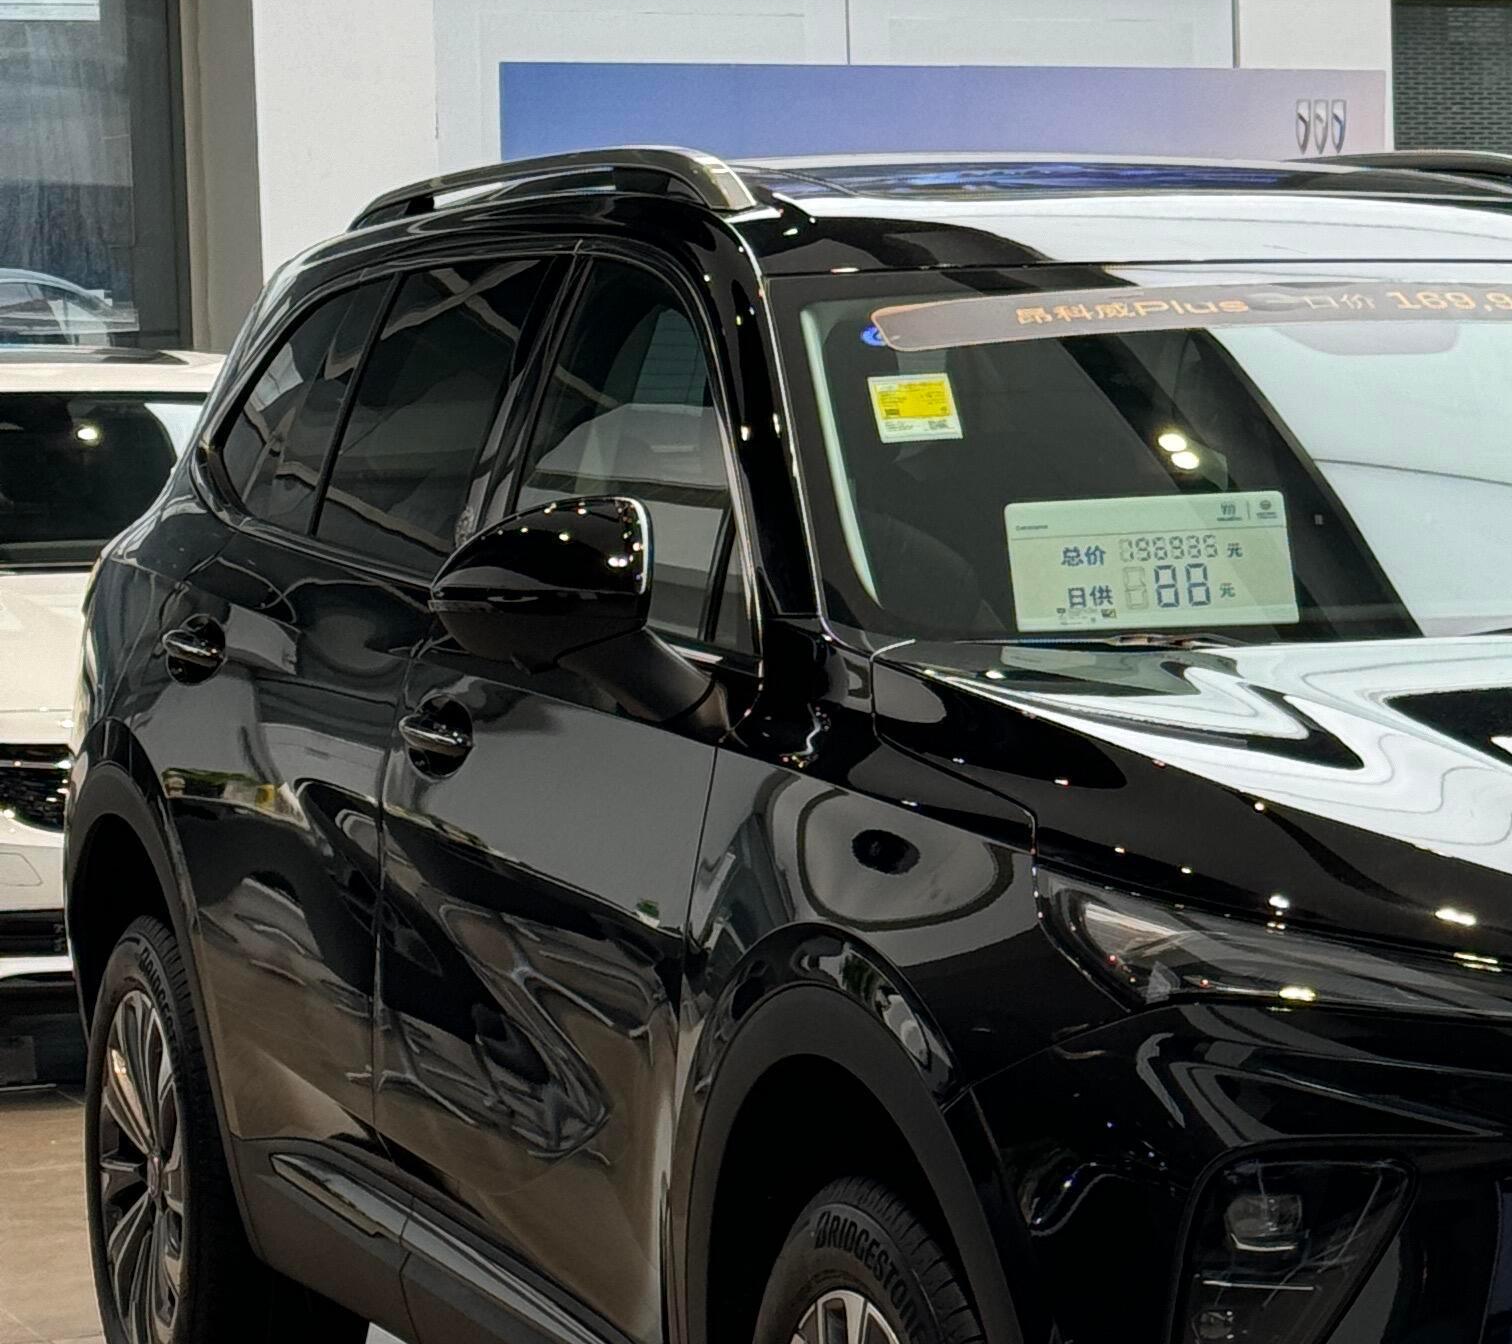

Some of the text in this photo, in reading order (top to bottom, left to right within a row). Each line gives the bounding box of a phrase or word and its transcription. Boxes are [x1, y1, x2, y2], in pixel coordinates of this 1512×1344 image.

[1016, 300, 1249, 325] 昂科威Plus
[1061, 545, 1107, 567] 总价
[1226, 542, 1243, 558] 元
[1067, 584, 1114, 609] 日供
[1219, 582, 1236, 598] 元
